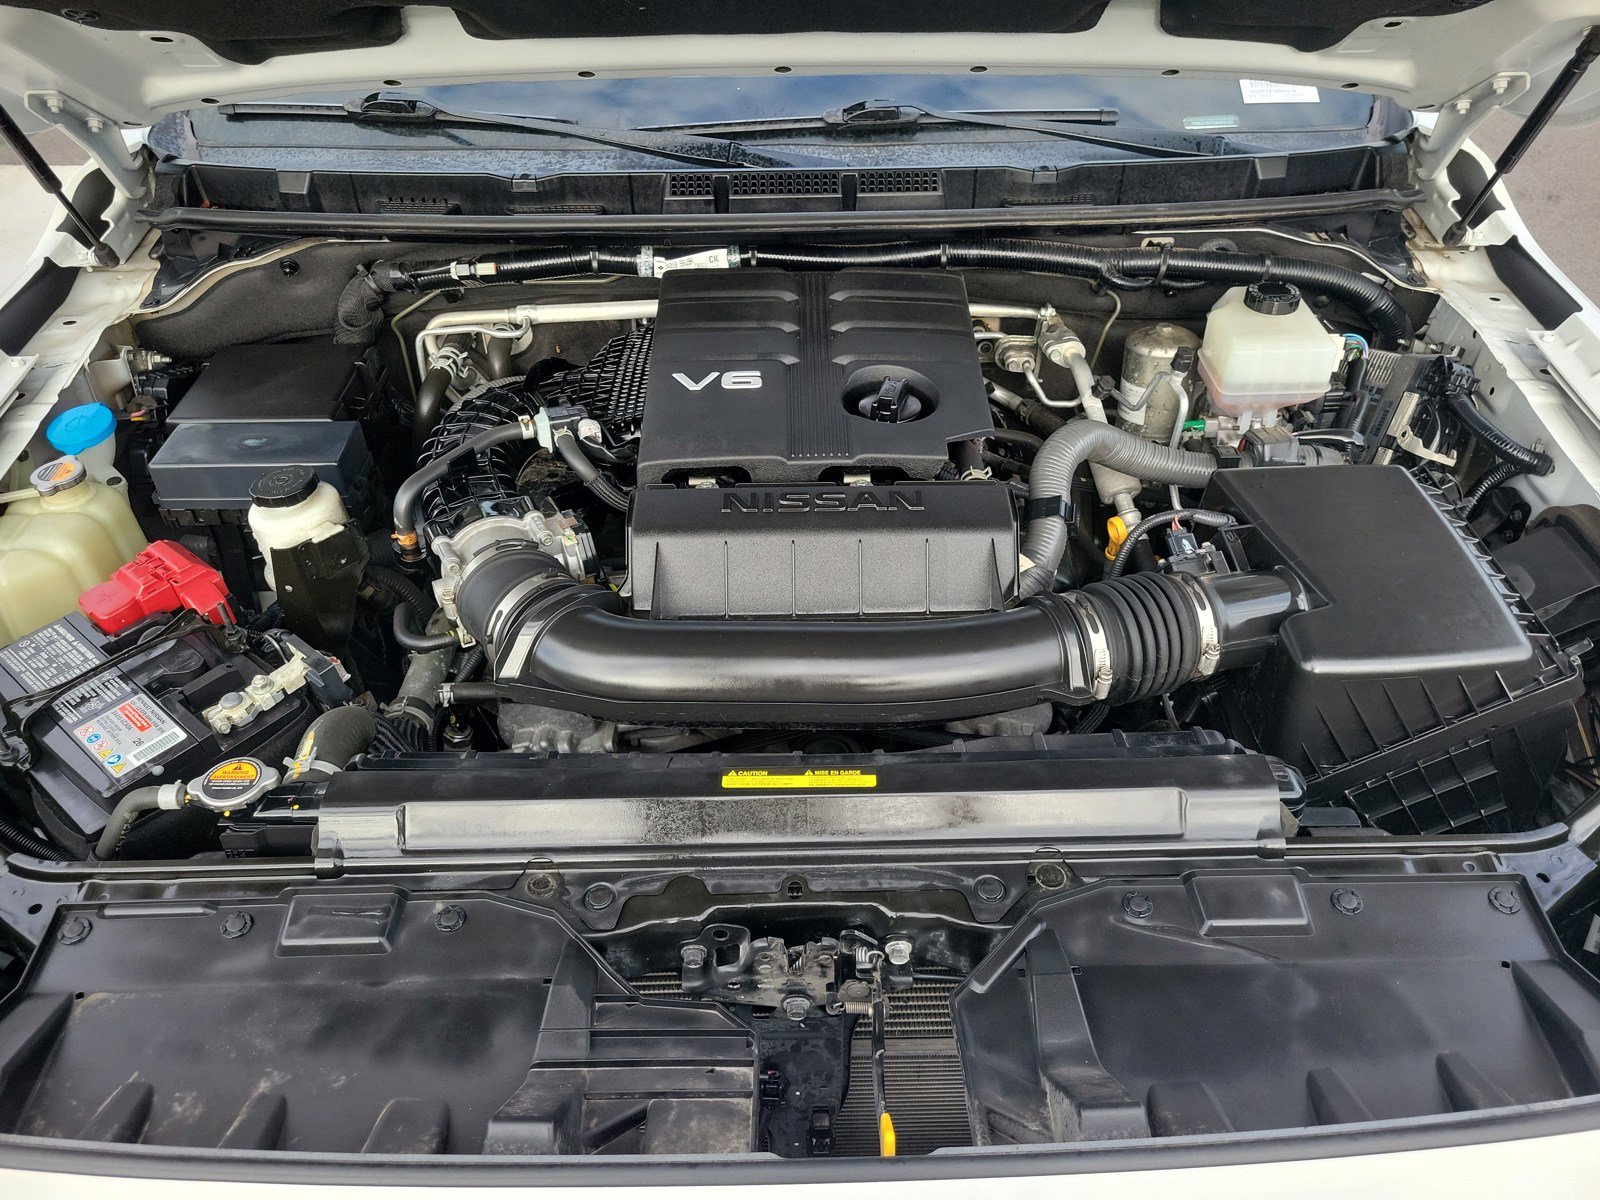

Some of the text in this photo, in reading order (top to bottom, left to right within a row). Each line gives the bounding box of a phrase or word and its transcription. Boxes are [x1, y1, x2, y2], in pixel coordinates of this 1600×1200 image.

[708, 254, 720, 264] CK
[672, 370, 763, 391] V6
[721, 490, 925, 513] NISSAN
[132, 737, 144, 747] 26
